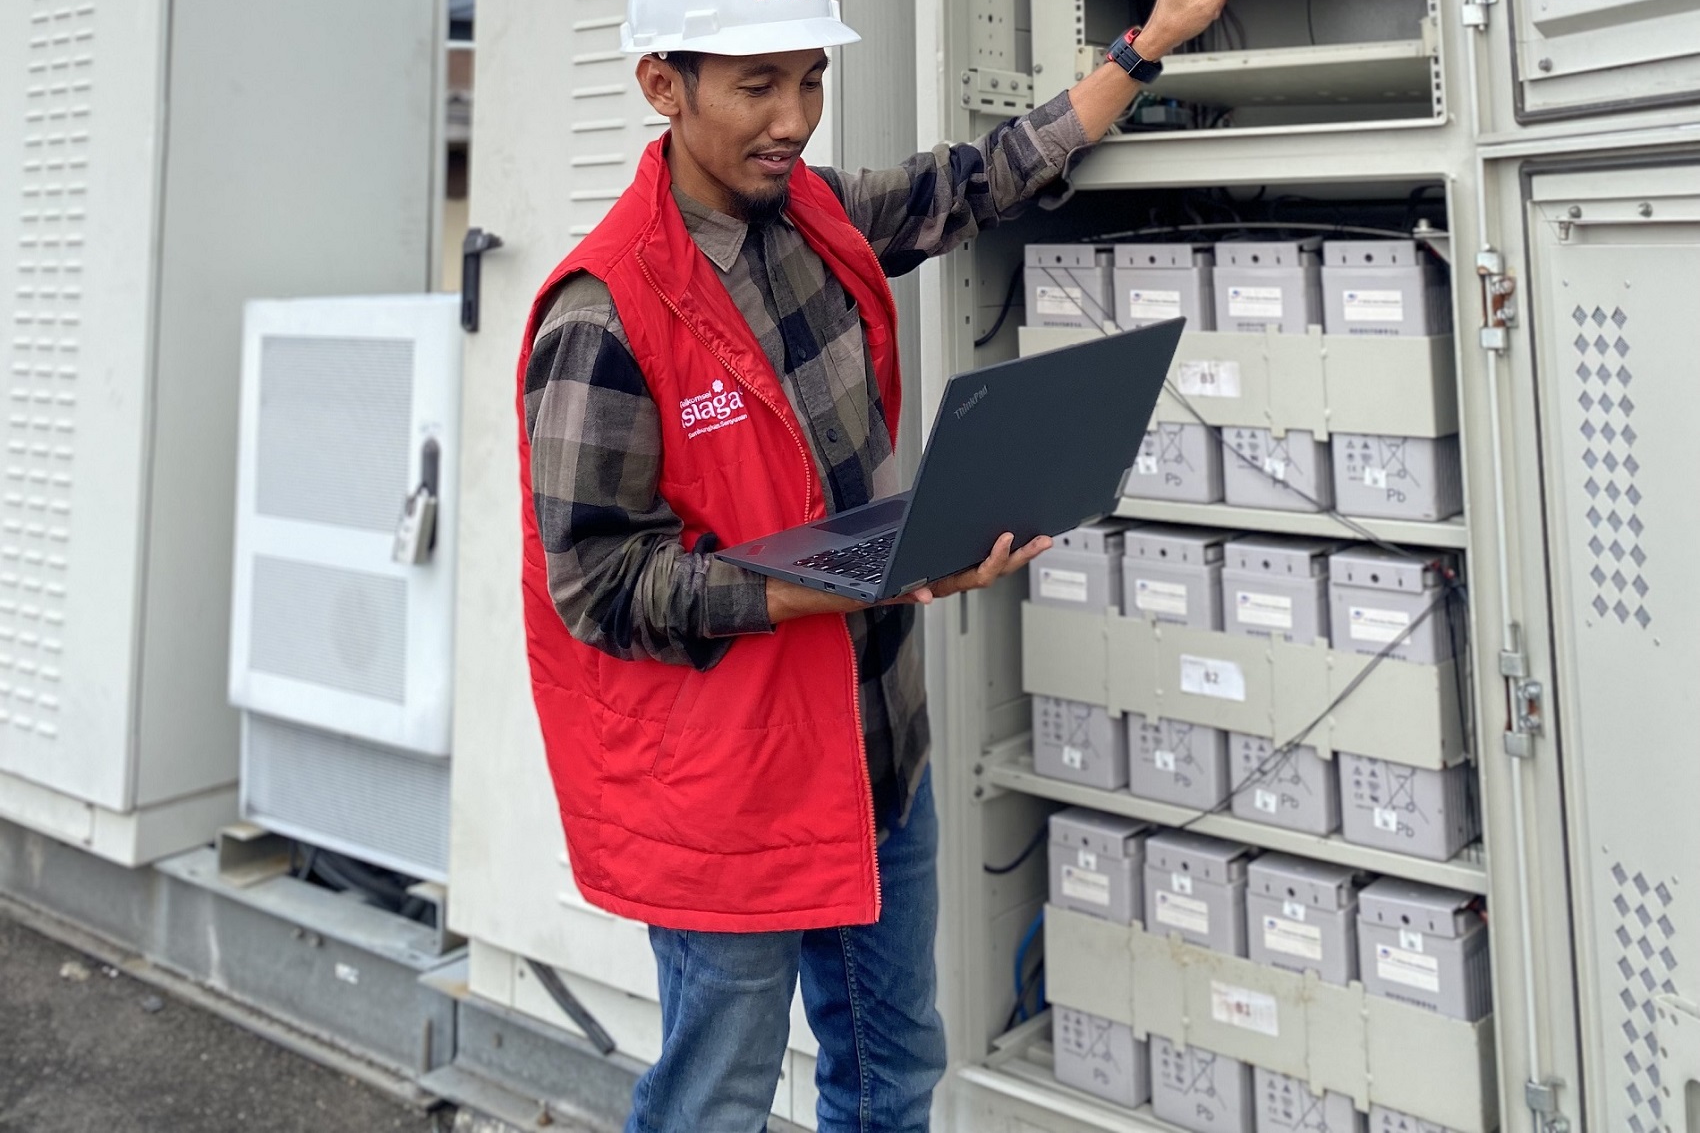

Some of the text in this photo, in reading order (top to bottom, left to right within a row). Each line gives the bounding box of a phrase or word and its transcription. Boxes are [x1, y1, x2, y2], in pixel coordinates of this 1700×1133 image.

[681, 391, 744, 427] siaga
[954, 385, 988, 420] ThinkPad
[1386, 488, 1406, 503] Pb
[1281, 793, 1299, 808] Pb
